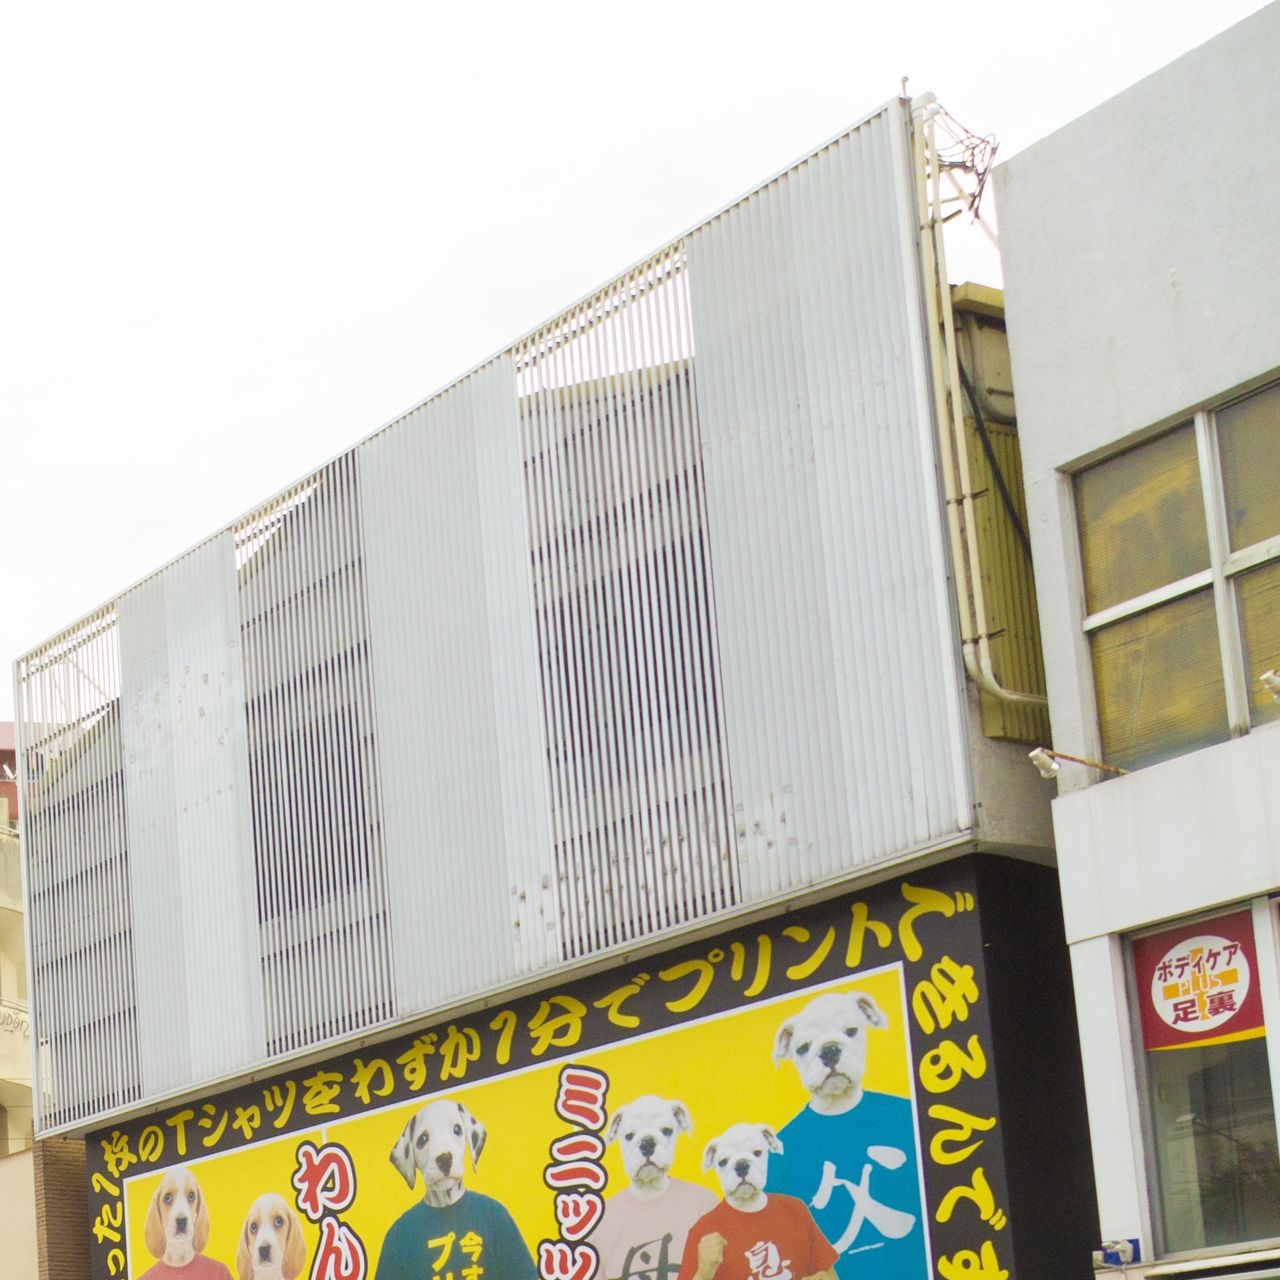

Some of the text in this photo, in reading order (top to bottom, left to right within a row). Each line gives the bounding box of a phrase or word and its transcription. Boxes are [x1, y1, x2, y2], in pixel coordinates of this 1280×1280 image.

[1156, 943, 1241, 983] ボディケア
[1178, 975, 1224, 997] PLUS
[1171, 990, 1238, 1025] 足裏
[809, 1144, 917, 1255] 父
